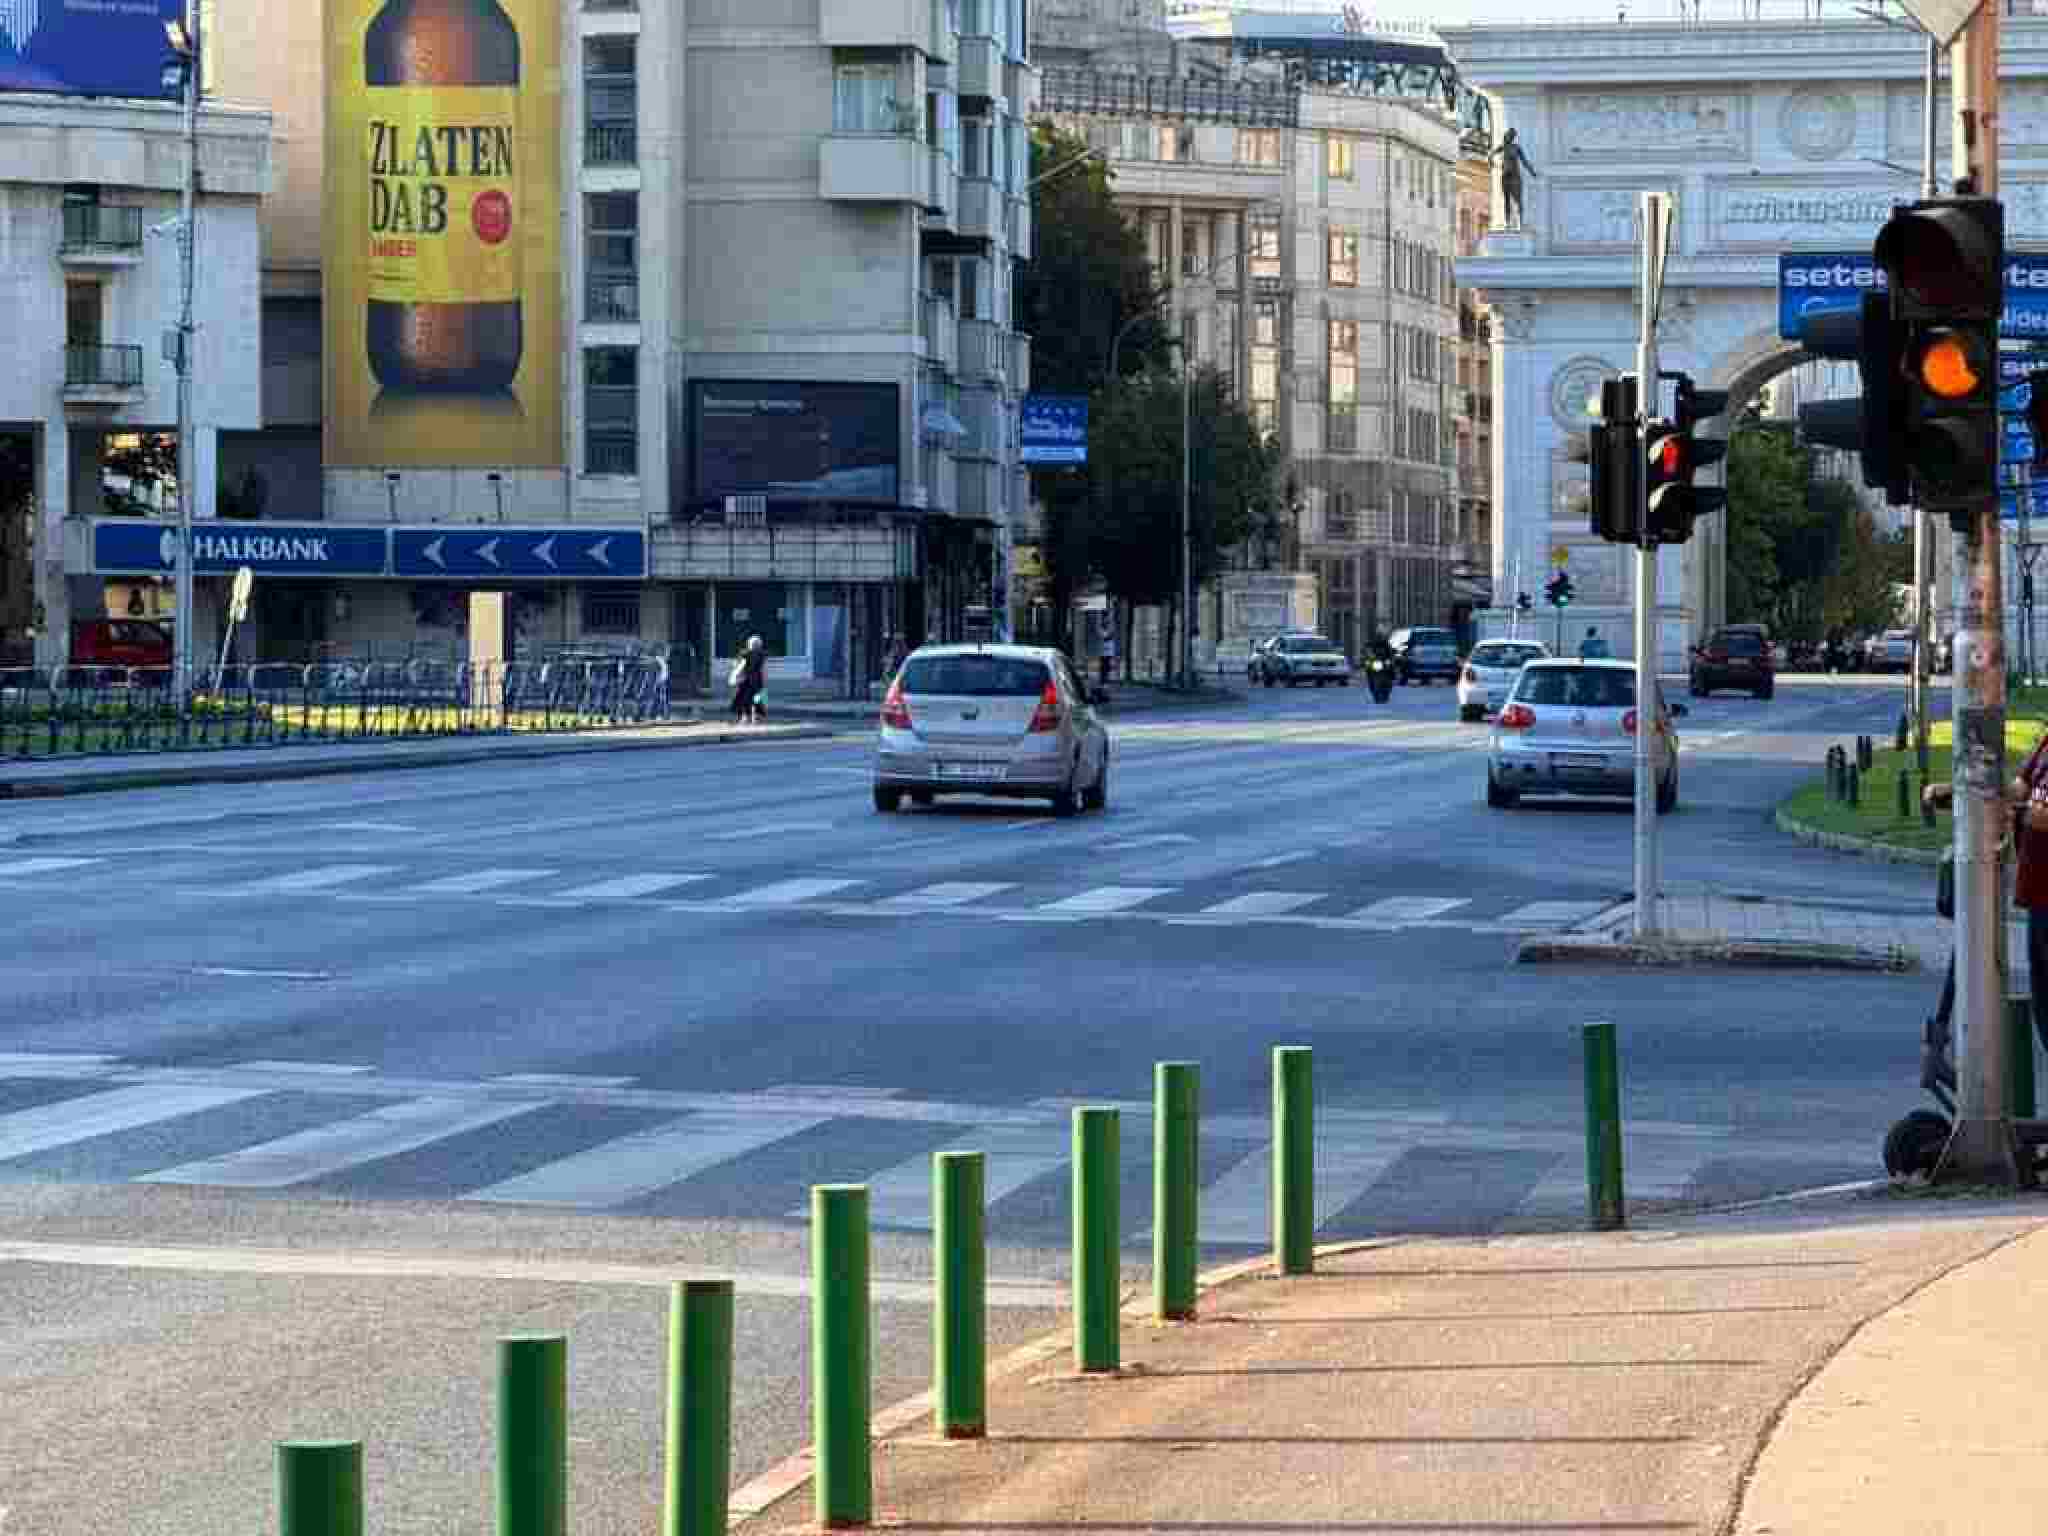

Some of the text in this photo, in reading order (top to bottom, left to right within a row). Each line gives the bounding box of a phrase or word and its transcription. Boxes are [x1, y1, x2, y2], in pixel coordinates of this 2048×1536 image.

[370, 120, 513, 176] ZLATEN
[371, 177, 448, 233] DAB
[193, 535, 329, 560] HALKBANK
